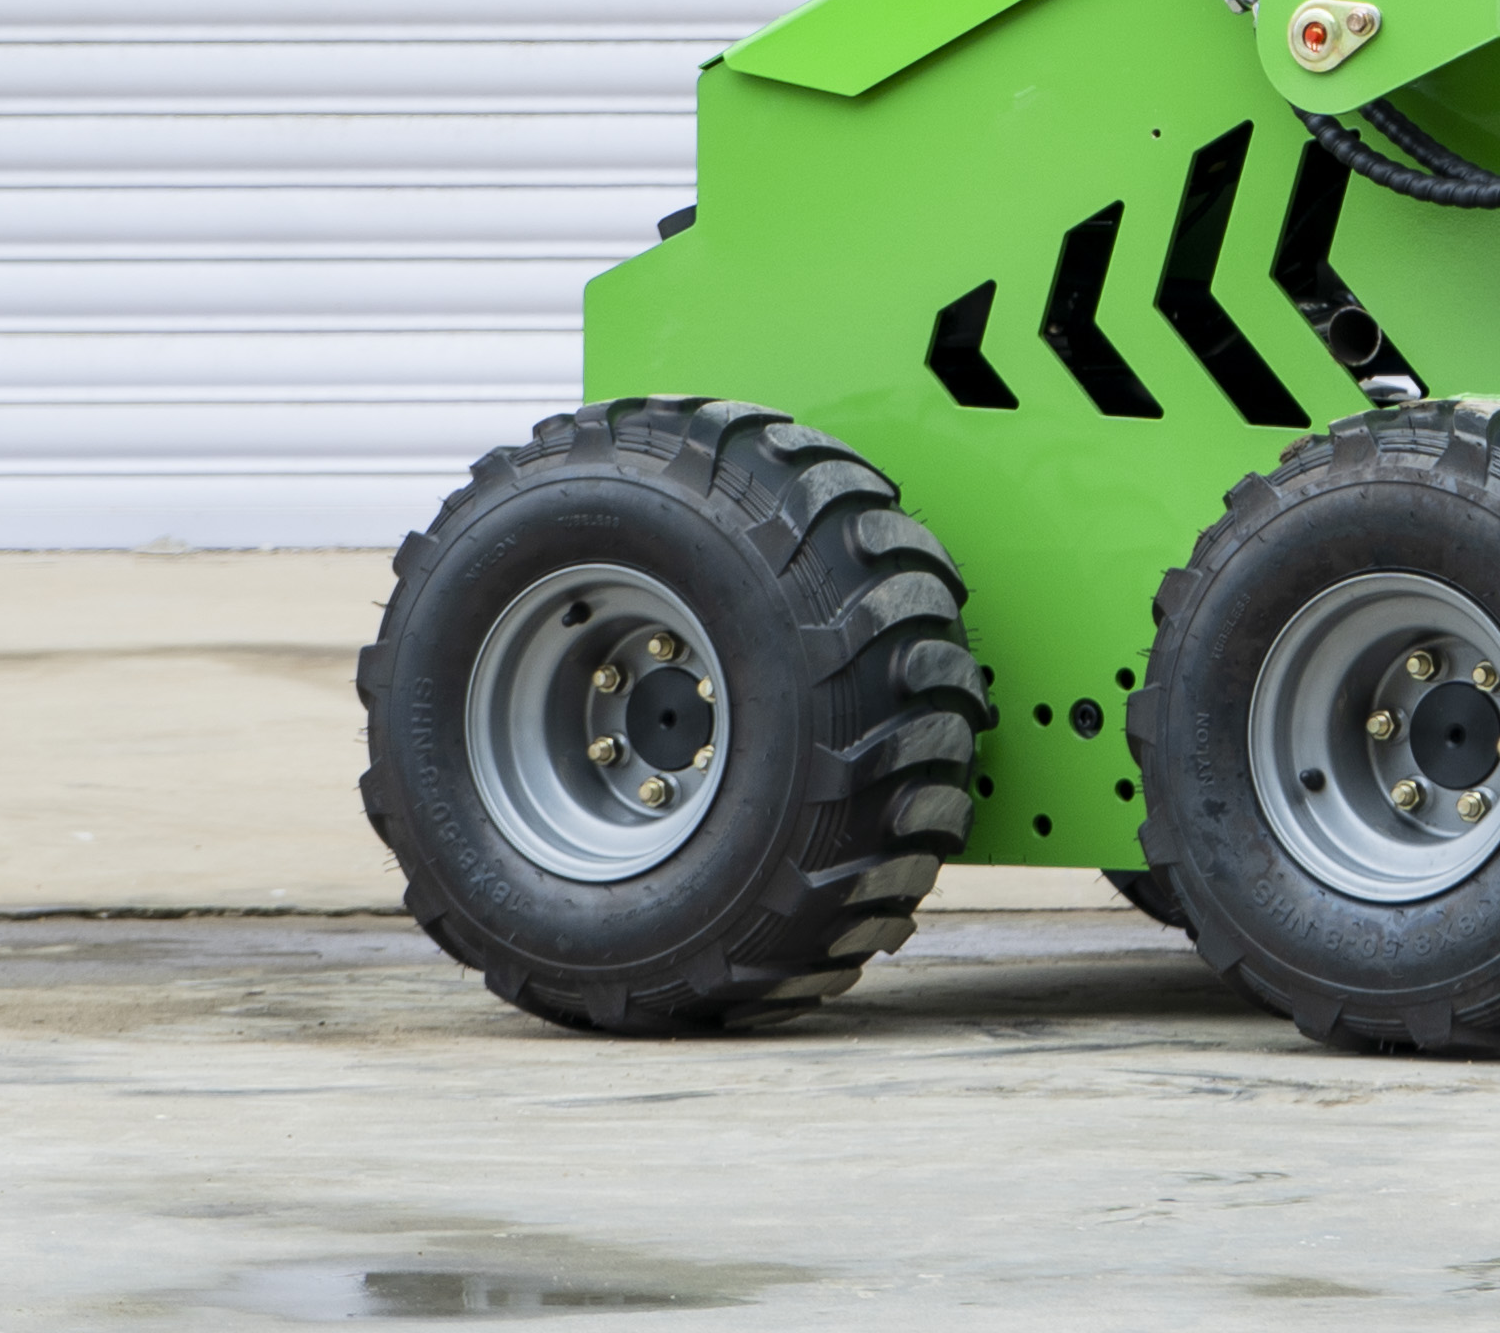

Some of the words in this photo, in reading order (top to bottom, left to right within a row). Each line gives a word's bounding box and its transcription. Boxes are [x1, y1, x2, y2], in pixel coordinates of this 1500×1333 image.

[465, 532, 518, 584] NYLON
[411, 676, 436, 763] NHS
[1195, 711, 1215, 787] NYLON
[1251, 879, 1319, 939] NHS
